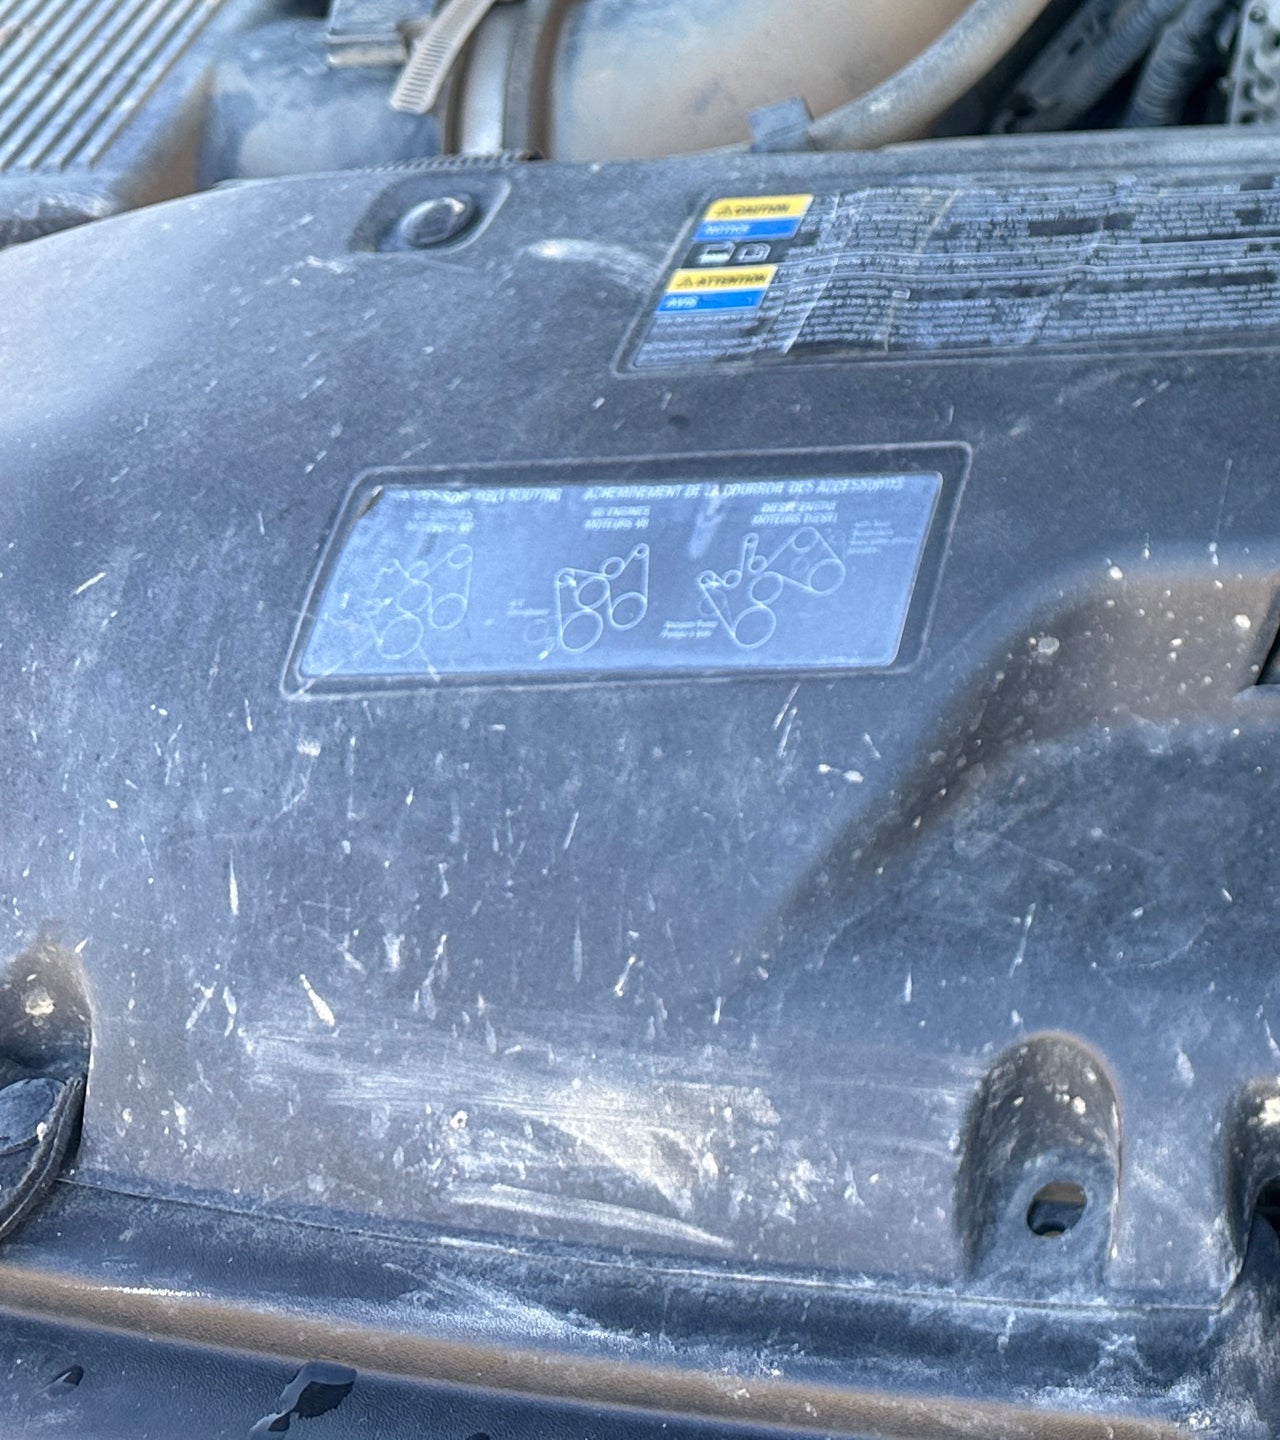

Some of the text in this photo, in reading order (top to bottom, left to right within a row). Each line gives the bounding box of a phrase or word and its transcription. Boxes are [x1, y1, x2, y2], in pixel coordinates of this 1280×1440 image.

[735, 203, 791, 215] CAUTION
[704, 222, 751, 235] NOTICE
[696, 273, 767, 287] ATTENTION
[666, 295, 699, 308] AVIS
